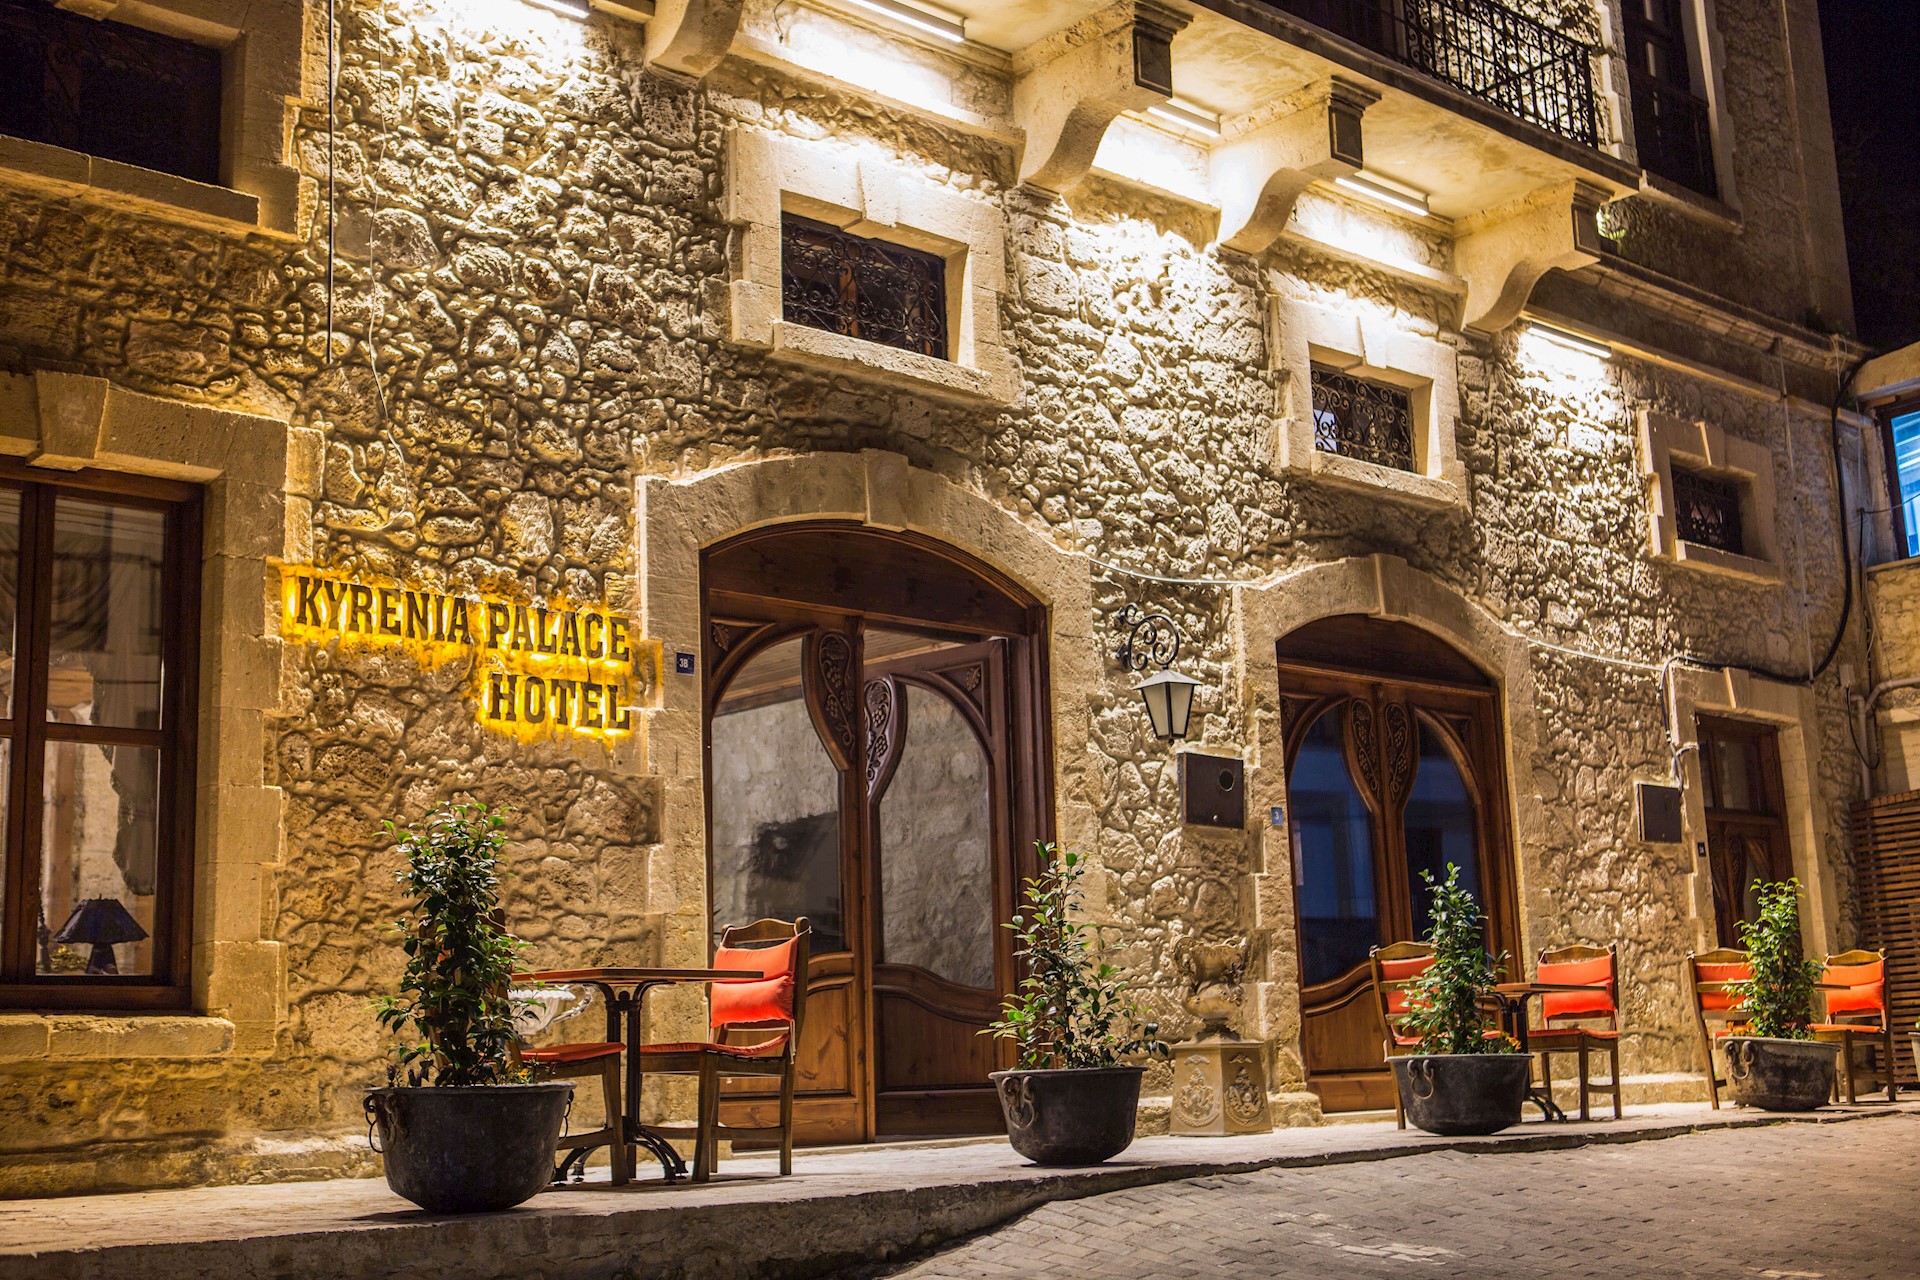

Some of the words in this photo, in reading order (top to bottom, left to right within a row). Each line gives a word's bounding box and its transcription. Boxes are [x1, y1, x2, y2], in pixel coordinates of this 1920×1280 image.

[296, 576, 471, 645] KYRENIA
[488, 603, 630, 662] PALACE
[679, 657, 689, 668] 3B
[490, 673, 630, 730] HOTEL
[1274, 810, 1280, 820] 3
